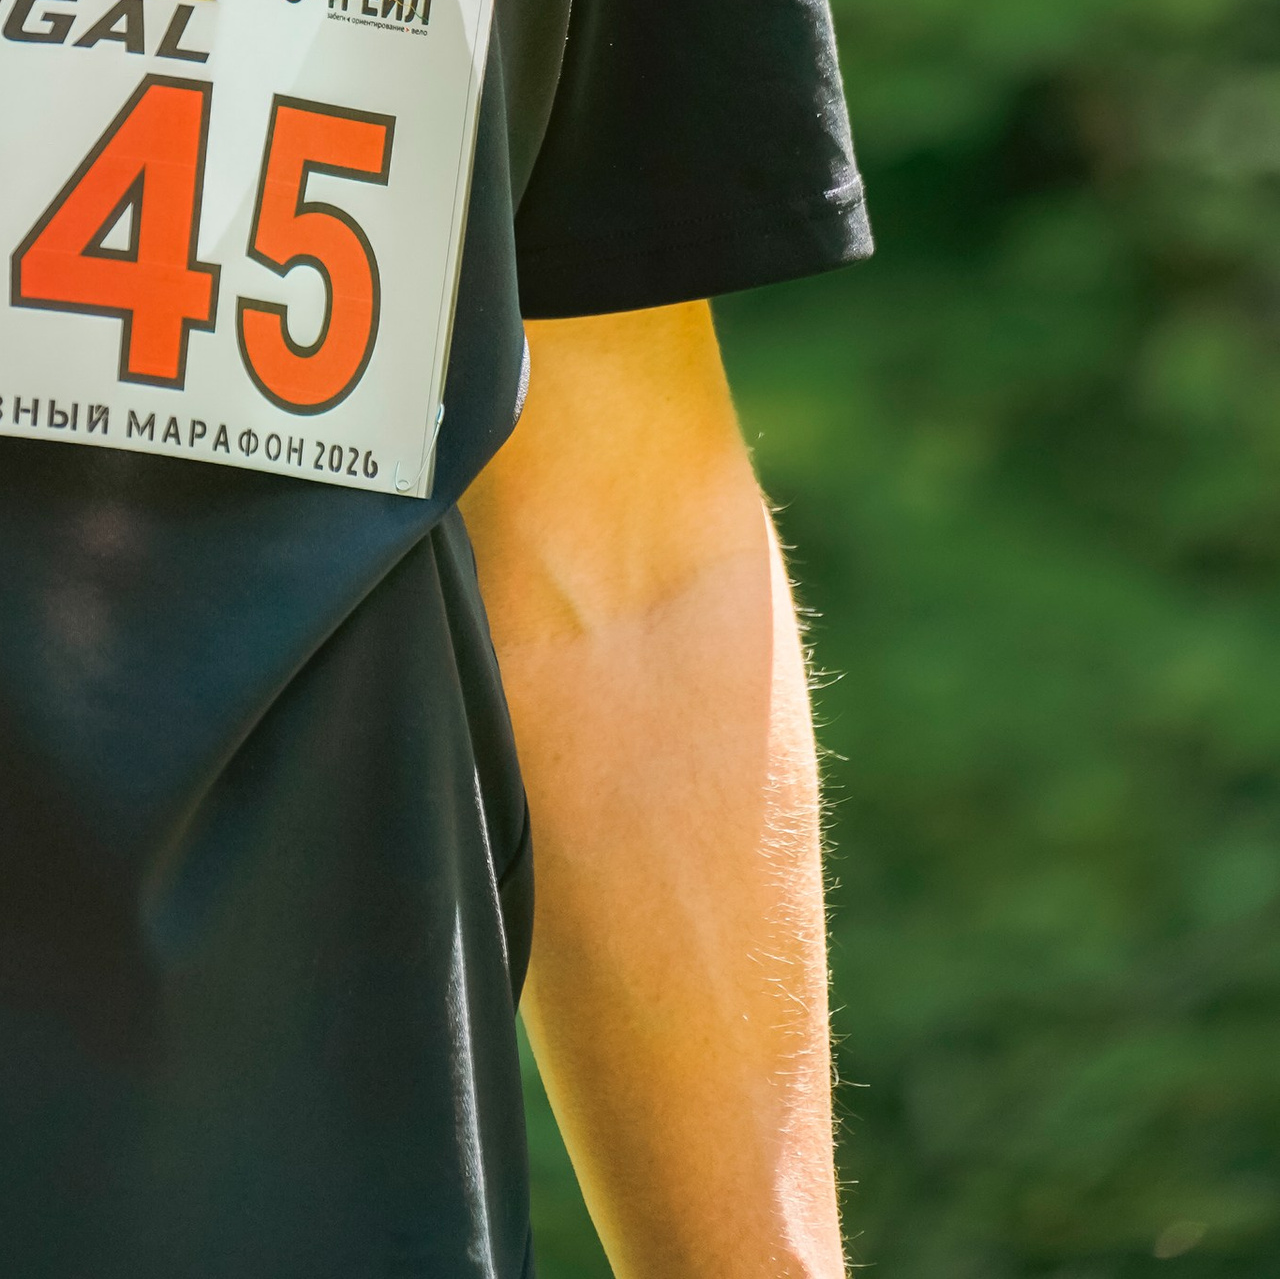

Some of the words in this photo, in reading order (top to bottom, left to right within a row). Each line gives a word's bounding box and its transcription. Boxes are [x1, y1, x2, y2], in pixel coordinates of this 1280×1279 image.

[351, 17, 405, 32] ориентирование
[411, 27, 428, 36] вело
[126, 409, 305, 467] МАРАФОН
[313, 441, 379, 479] 2026
